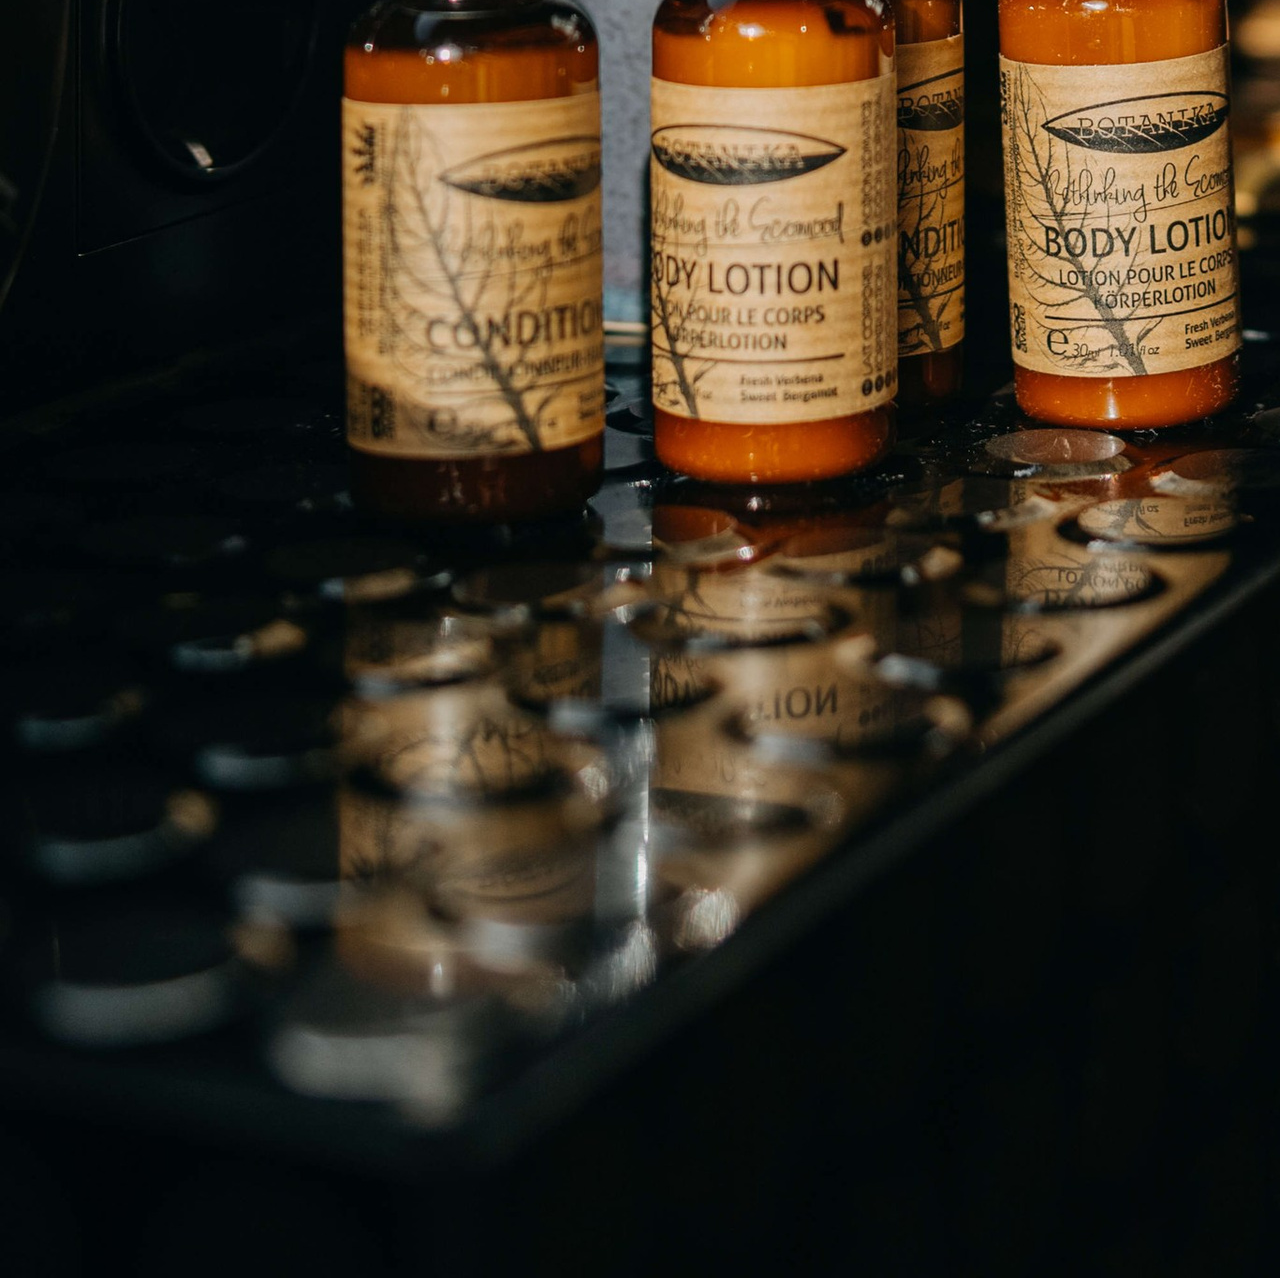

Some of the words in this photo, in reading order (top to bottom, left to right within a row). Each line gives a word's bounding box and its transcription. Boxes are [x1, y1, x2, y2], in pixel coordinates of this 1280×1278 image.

[1076, 103, 1218, 140] BOTANIKA
[659, 135, 805, 170] BOTANIKA
[1153, 162, 1180, 200] the
[1045, 226, 1137, 259] BODY
[654, 251, 698, 290] ODY
[708, 258, 840, 295] LOTION
[1059, 268, 1122, 287] LOTION
[1127, 264, 1175, 286] POUR
[1179, 260, 1197, 280] LE
[1199, 247, 1234, 275] CORPS
[1094, 278, 1217, 310] KÖRPERLOTION
[737, 307, 757, 326] LE
[763, 305, 826, 325] CORPS
[1184, 319, 1209, 335] Fresh
[1185, 334, 1213, 350] Sweet
